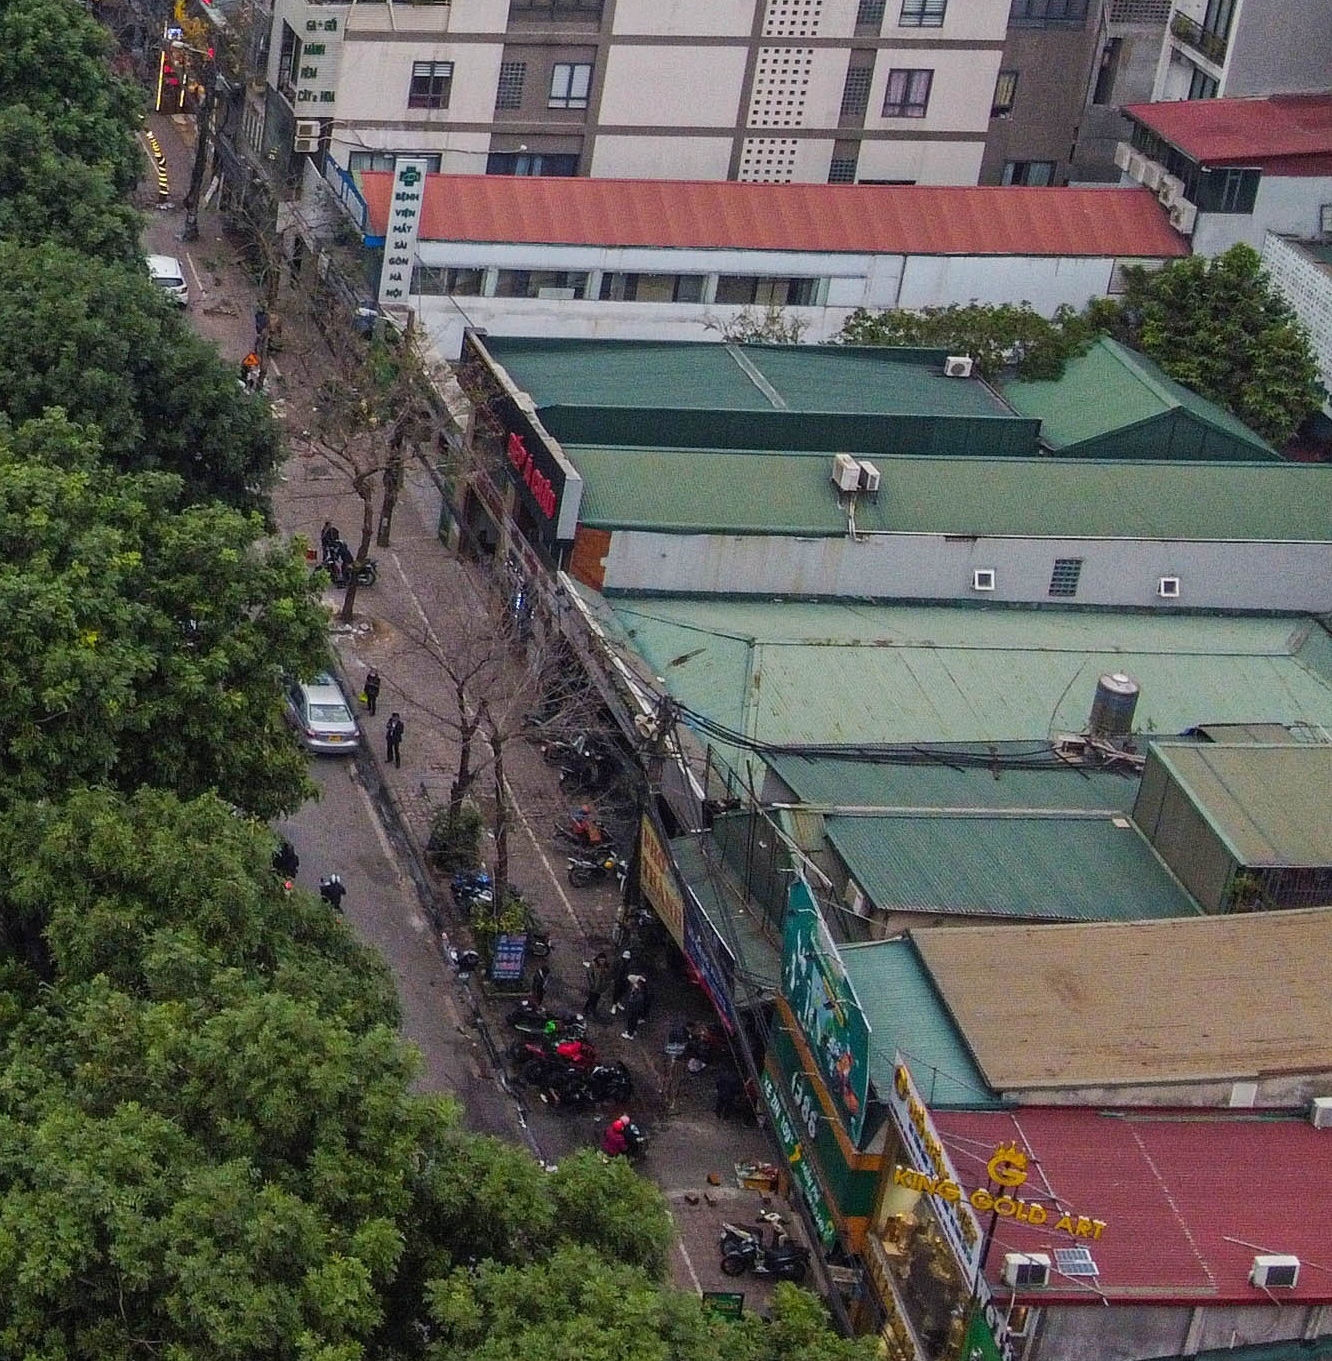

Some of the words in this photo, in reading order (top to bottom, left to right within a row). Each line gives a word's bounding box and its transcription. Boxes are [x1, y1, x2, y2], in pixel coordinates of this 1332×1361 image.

[894, 1165, 962, 1202] KING
[969, 1188, 1048, 1225] GOLD
[1054, 1211, 1107, 1240] ART
